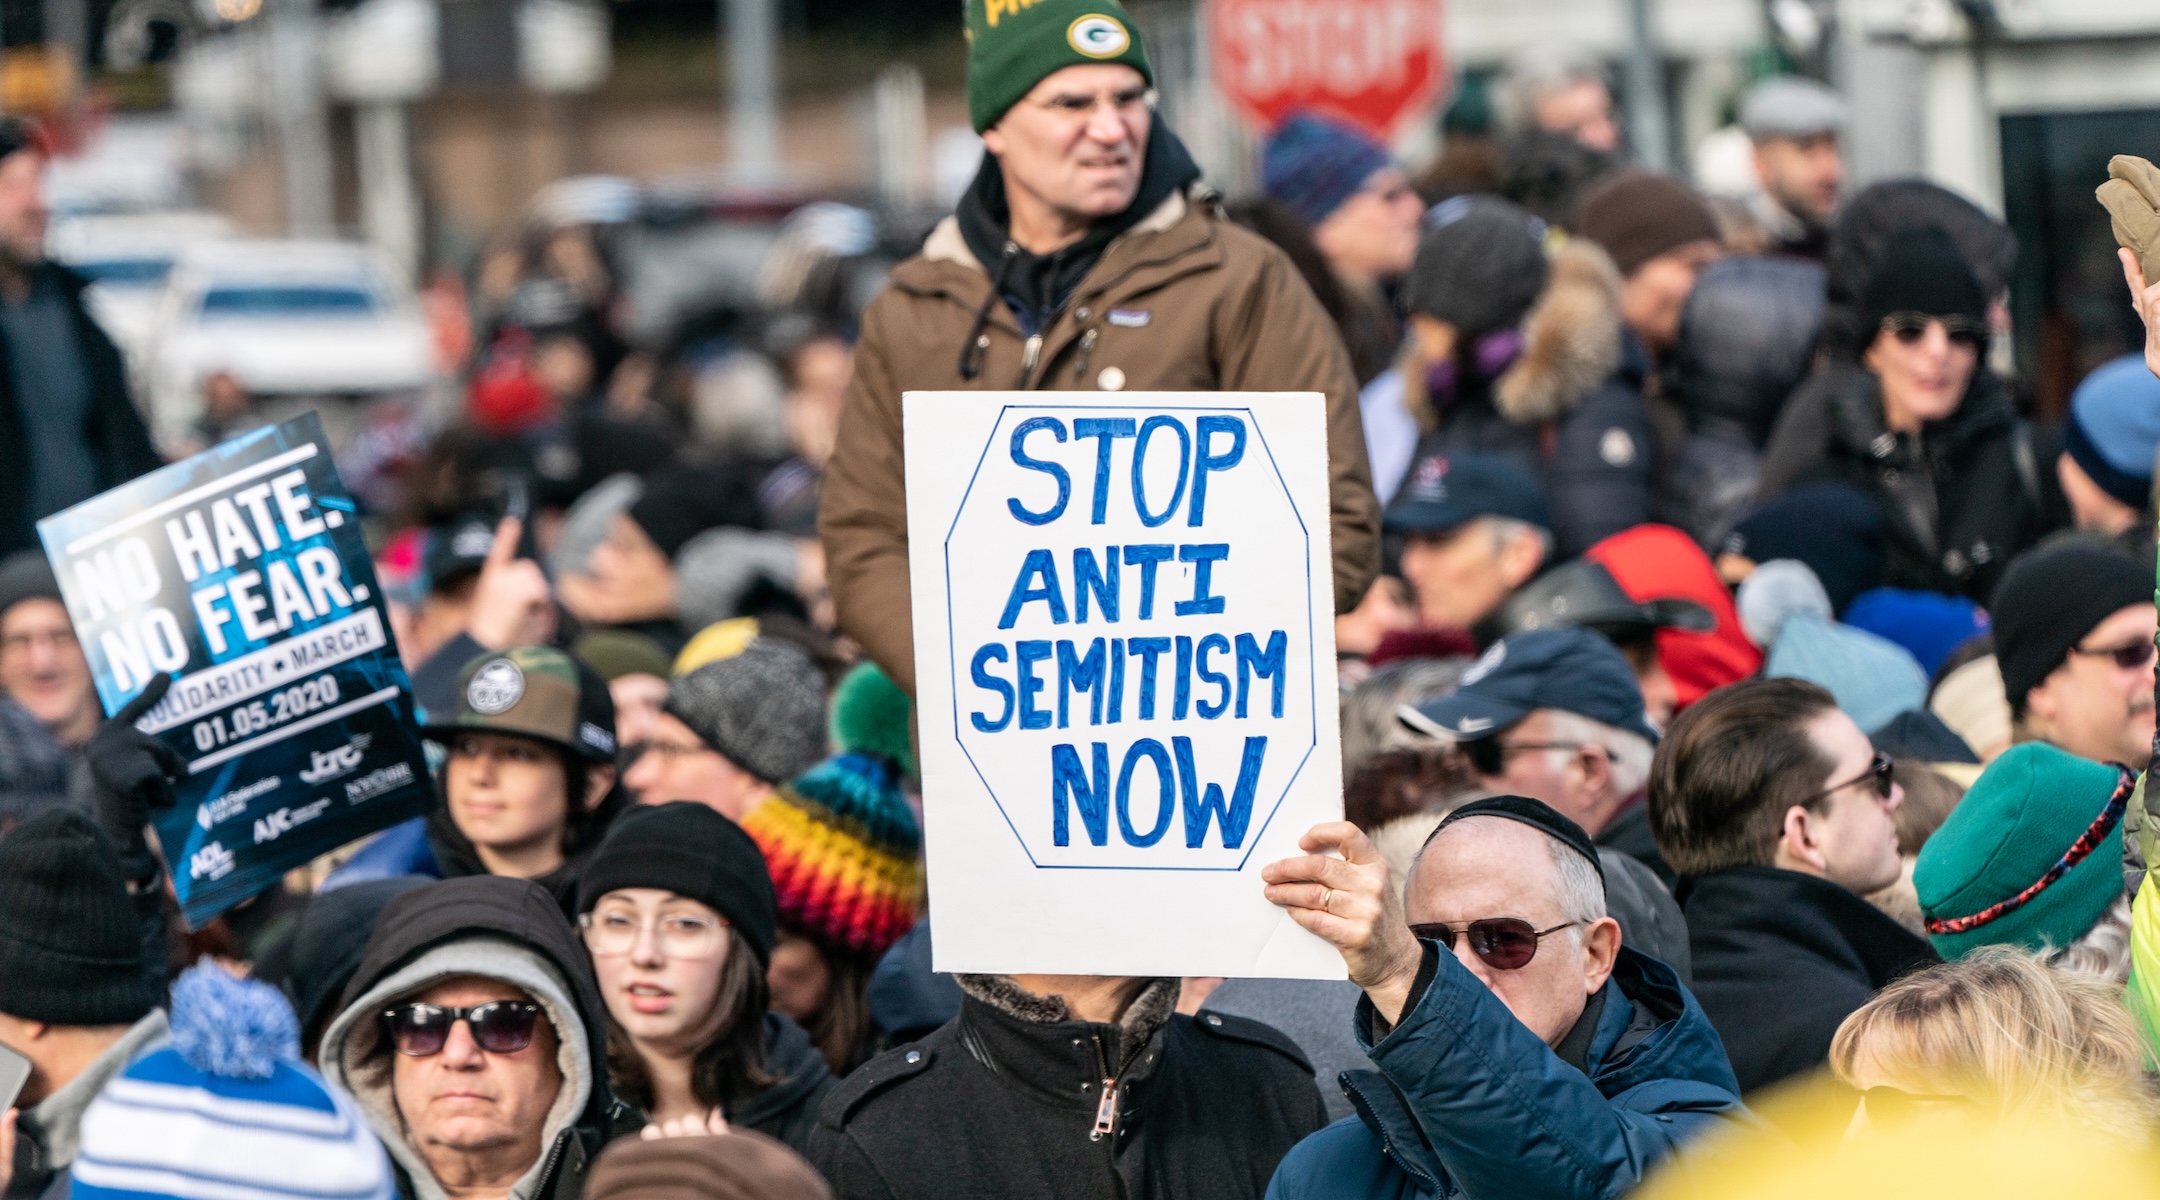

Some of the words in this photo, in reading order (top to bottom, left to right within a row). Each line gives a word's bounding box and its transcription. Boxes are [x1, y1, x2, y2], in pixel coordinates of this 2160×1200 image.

[1237, 1, 1412, 87] STOP
[1006, 415, 1247, 527] STOP
[72, 536, 162, 622] NO
[165, 468, 344, 583] HATE.
[997, 543, 1230, 629] ANTI
[101, 606, 190, 693] NO
[191, 547, 371, 655] FEAR.
[290, 622, 370, 669] MARCH
[192, 673, 341, 752] 01.05.2020
[969, 629, 1288, 733] SEMITISM
[1051, 735, 1268, 849] NOW
